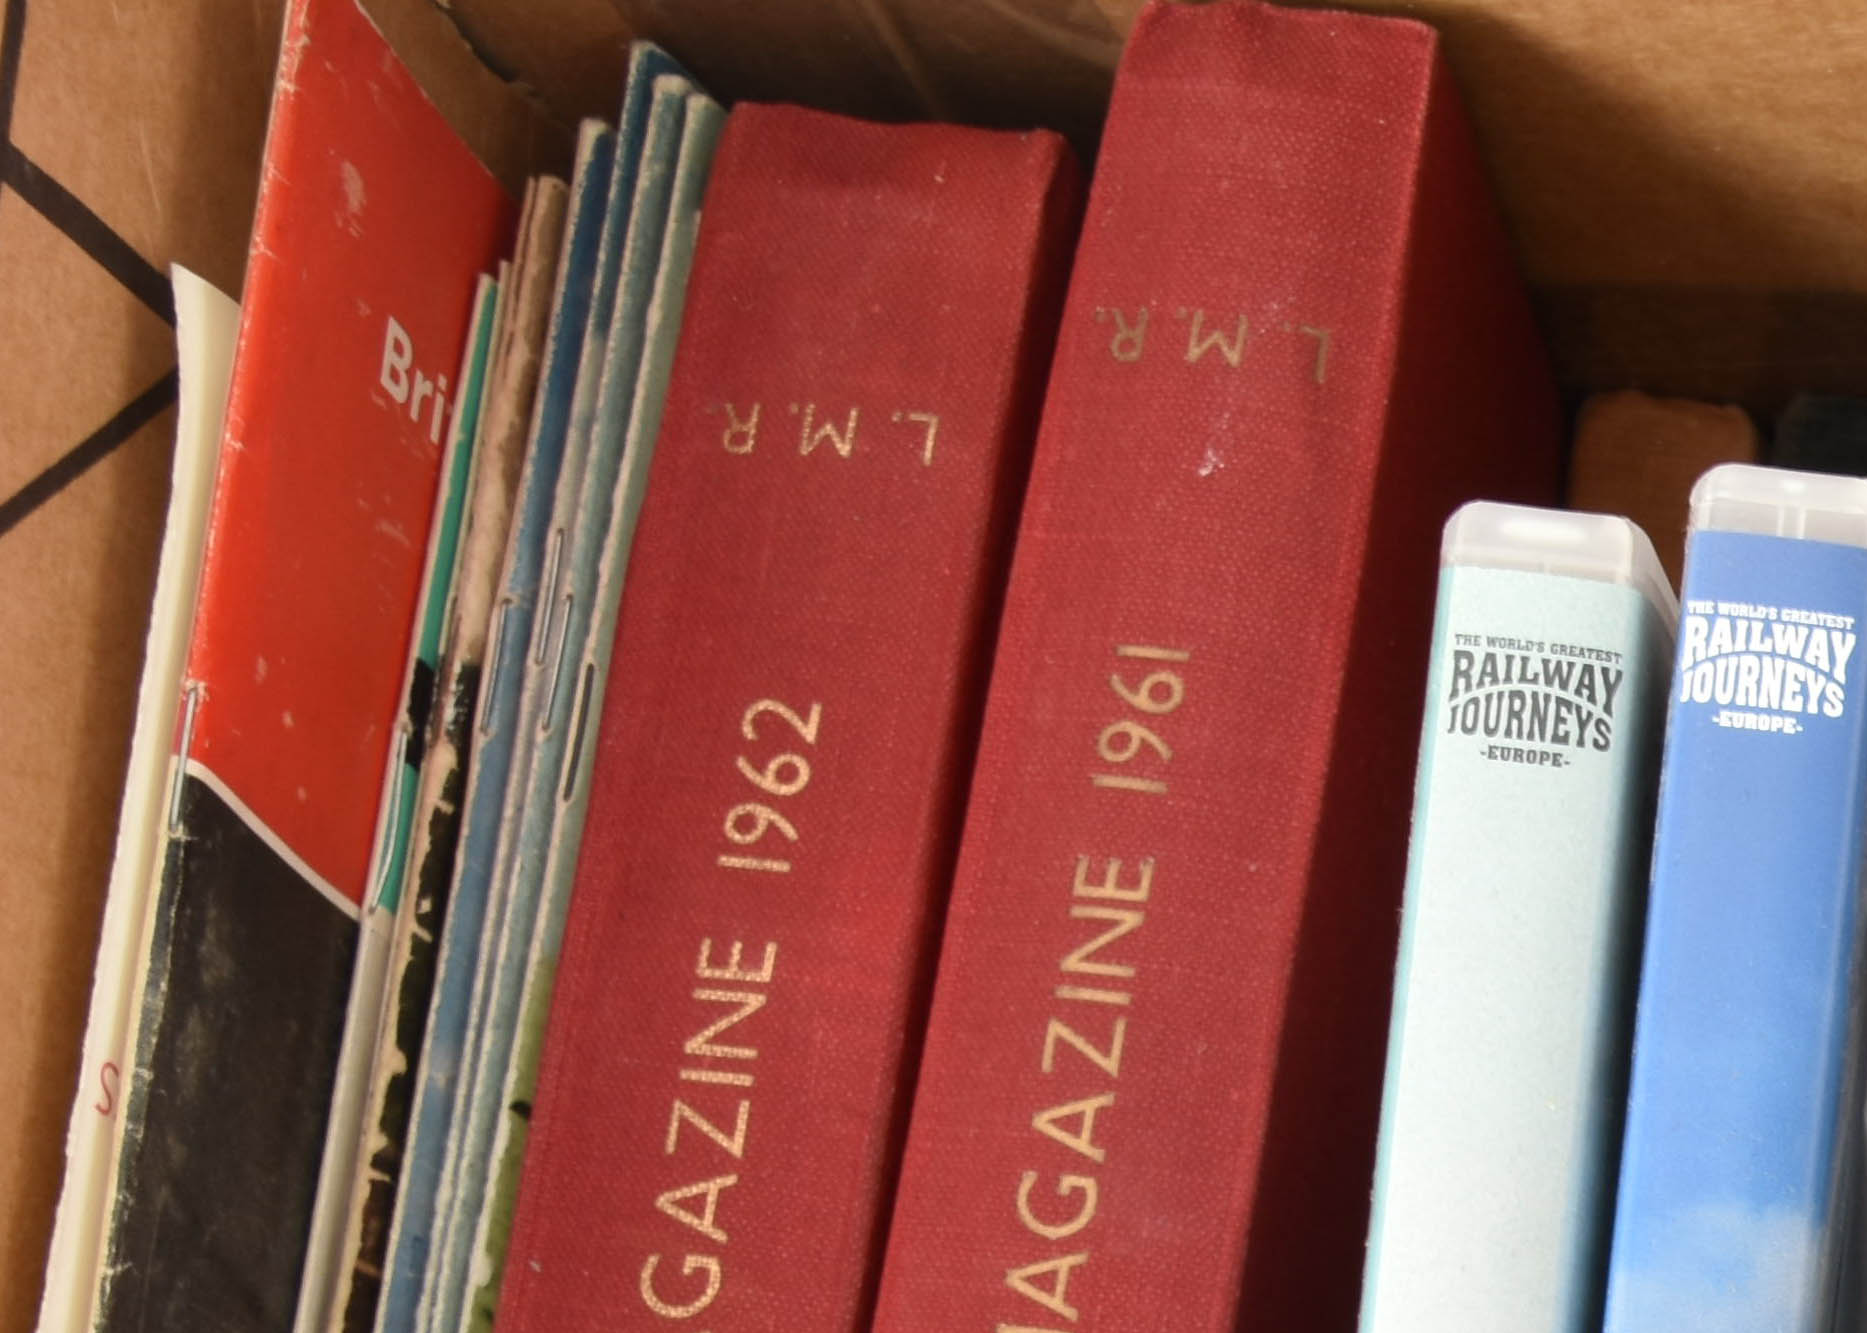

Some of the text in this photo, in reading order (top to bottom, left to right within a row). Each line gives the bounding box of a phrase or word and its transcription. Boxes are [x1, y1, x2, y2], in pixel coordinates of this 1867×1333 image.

[1454, 634, 1624, 664] THE WORLD'S GREATEST
[1687, 600, 1855, 631] THE WORLD'S GREATEST
[1449, 649, 1624, 718] RAILWAY
[1681, 616, 1857, 684] RAILWAY
[1679, 653, 1845, 719] JOURNEYS
[1089, 644, 1190, 796] 1961
[1447, 688, 1613, 753] JOURNEYS
[717, 697, 823, 873] 1962
